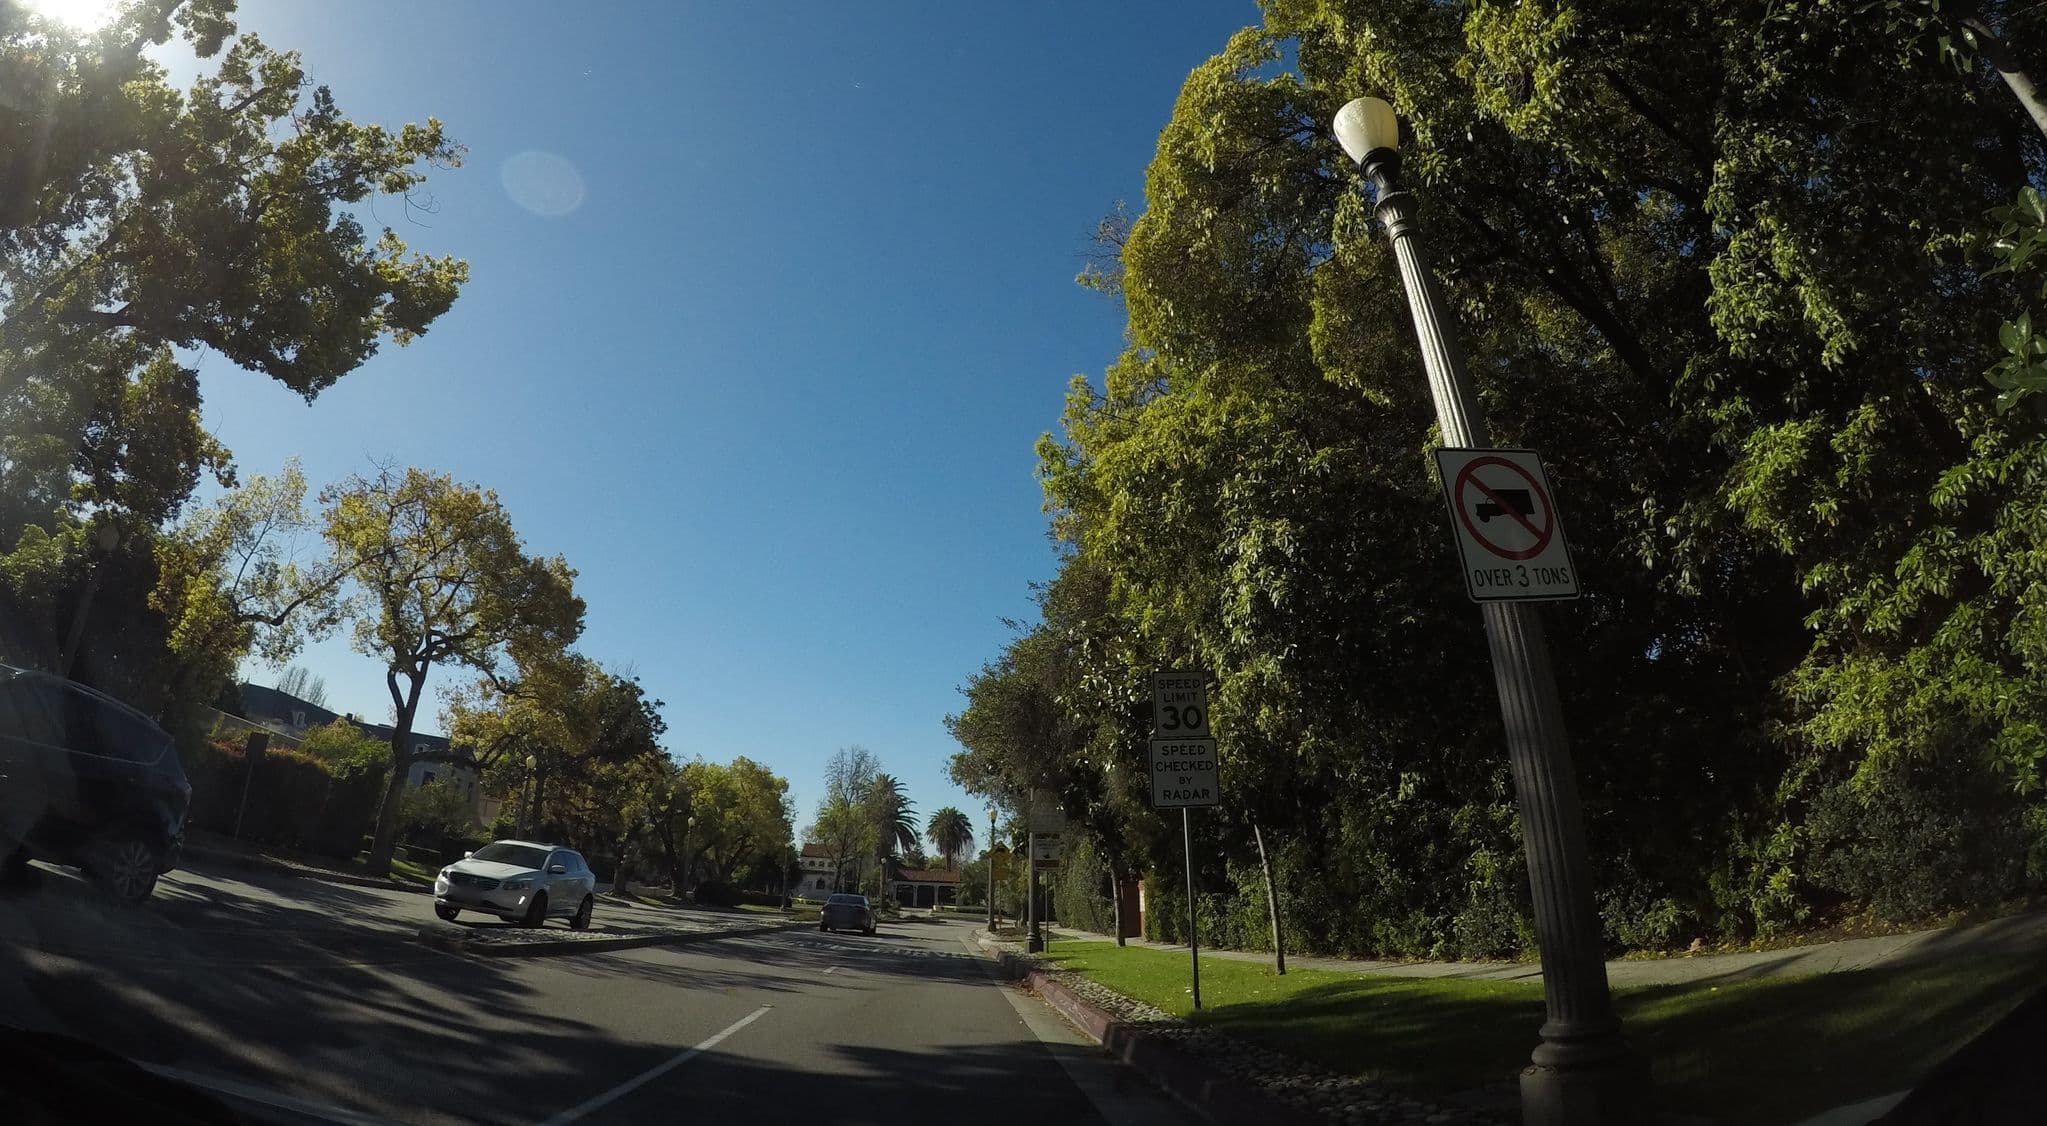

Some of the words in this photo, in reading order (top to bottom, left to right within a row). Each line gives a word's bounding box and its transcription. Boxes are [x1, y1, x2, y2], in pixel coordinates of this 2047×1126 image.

[1474, 569, 1513, 587] OVER
[1516, 564, 1530, 587] 3
[1532, 567, 1570, 585] TONS
[1158, 679, 1200, 689] SPEED
[1163, 692, 1197, 703] LIMIT
[1162, 706, 1202, 730] 30
[1162, 745, 1206, 756] SPEED
[1155, 760, 1213, 772] CHECKED
[1179, 776, 1193, 785] BY
[1163, 789, 1210, 801] RADAR
